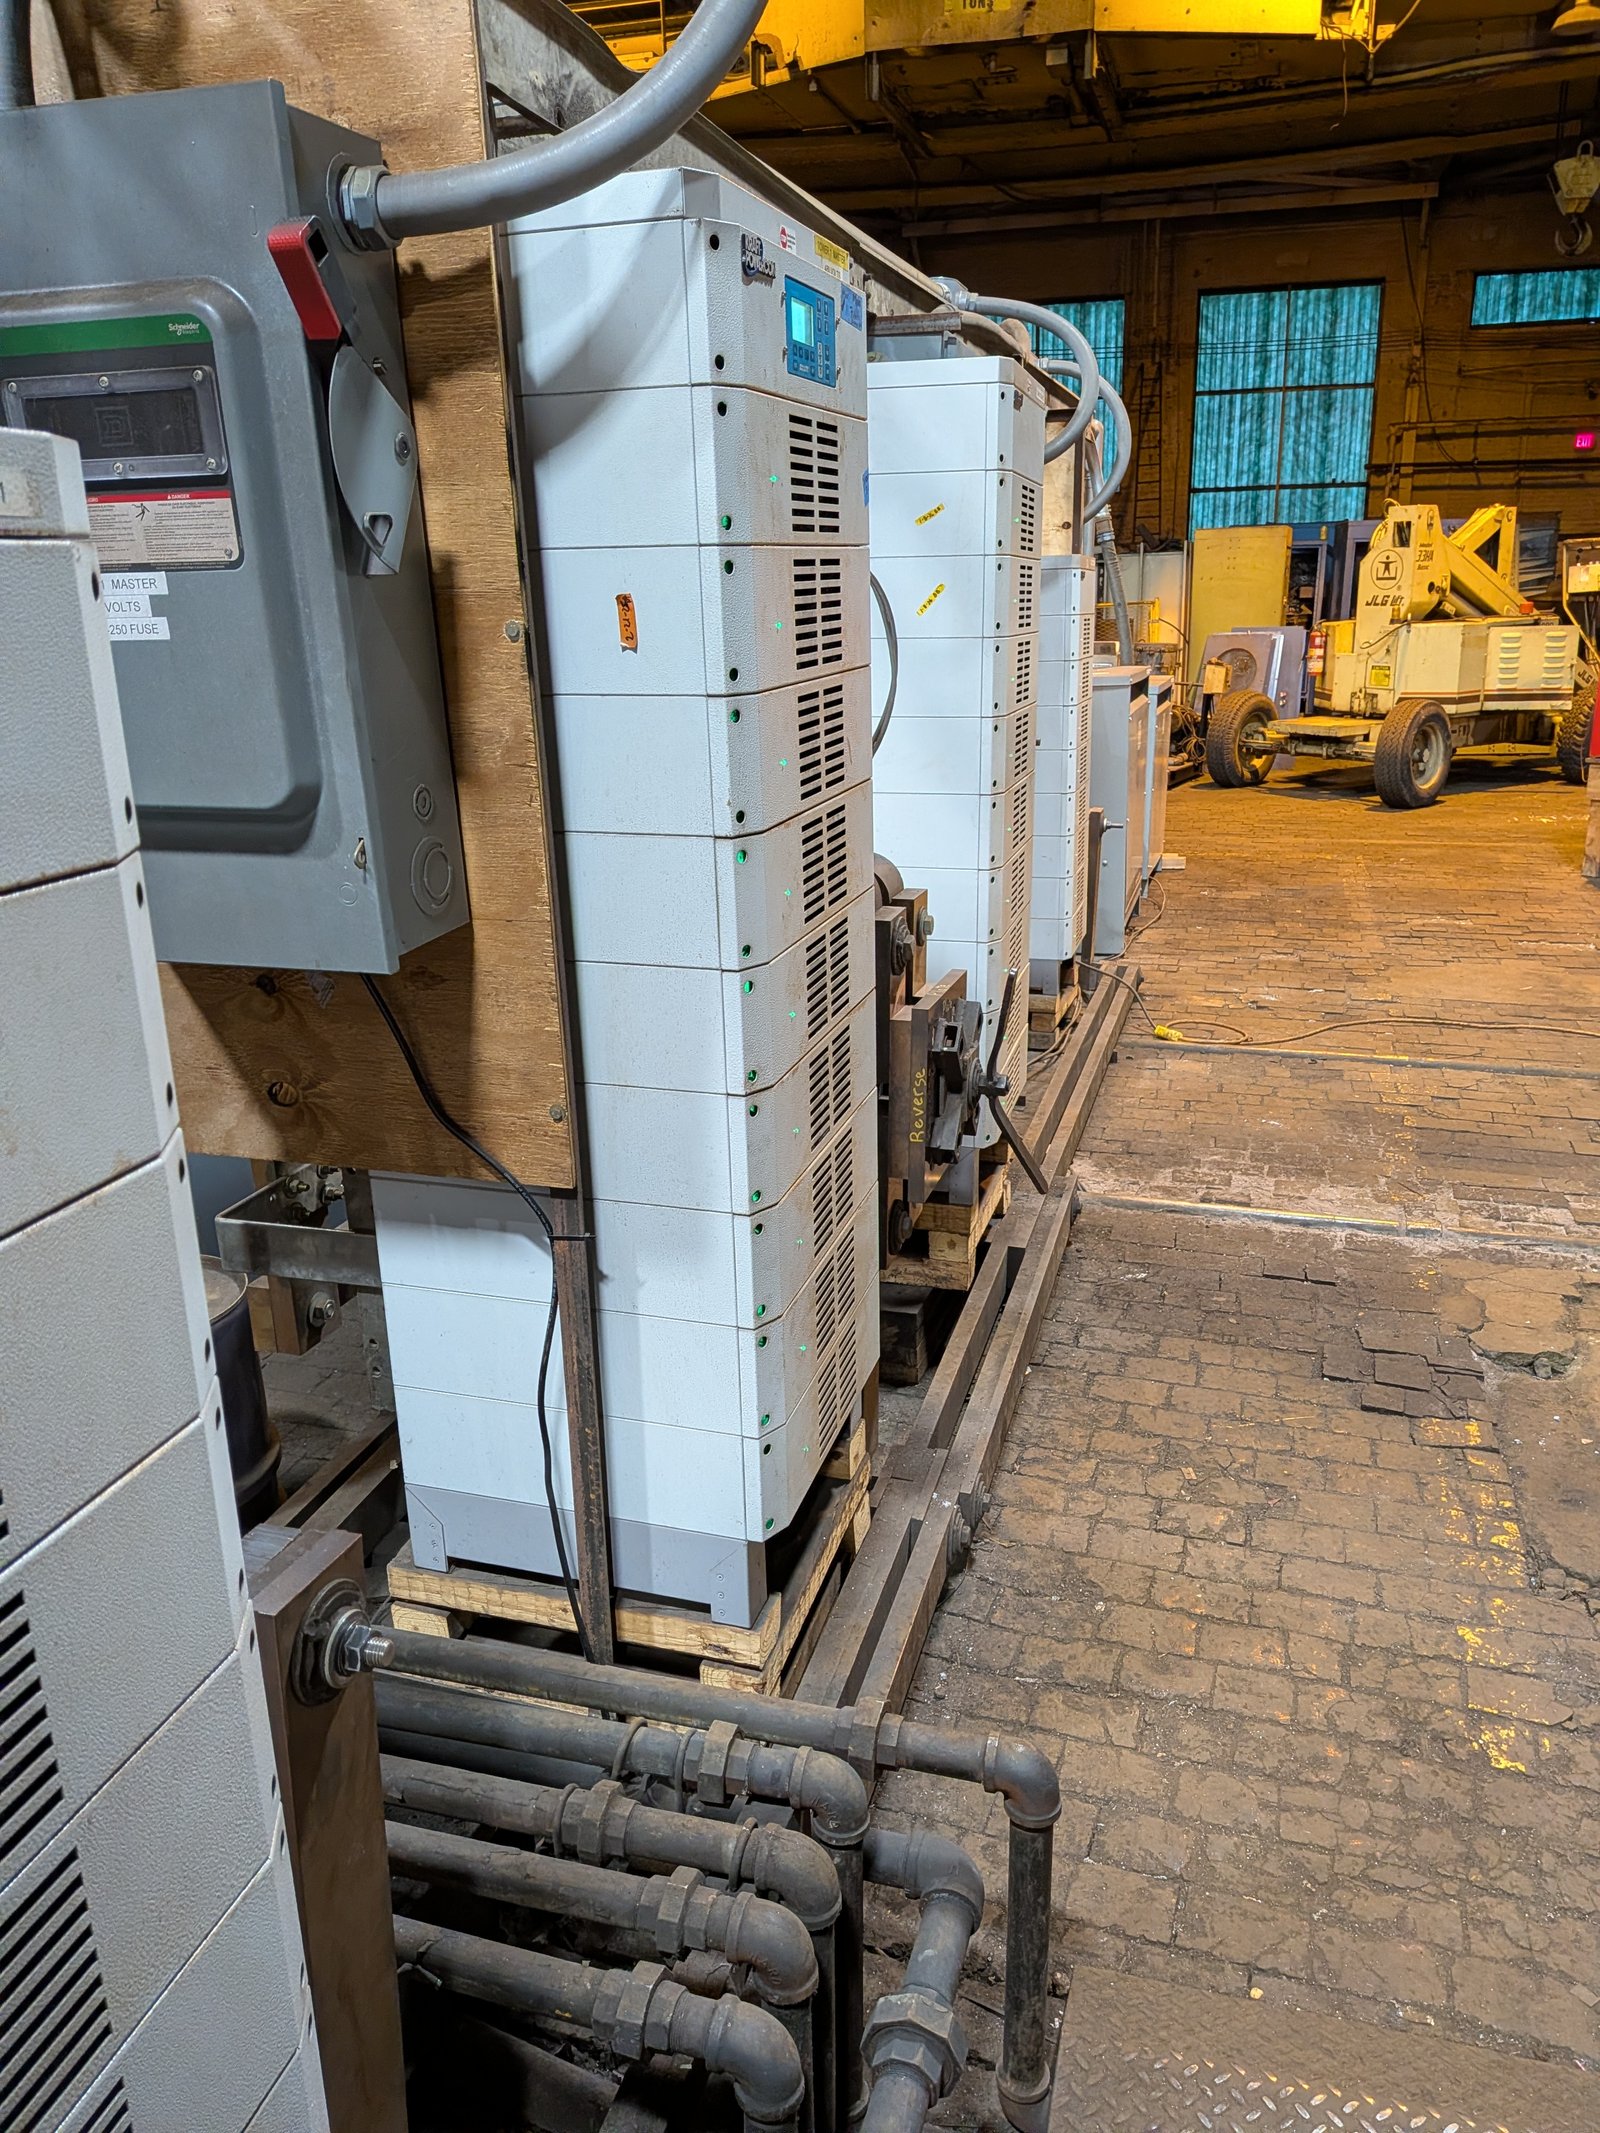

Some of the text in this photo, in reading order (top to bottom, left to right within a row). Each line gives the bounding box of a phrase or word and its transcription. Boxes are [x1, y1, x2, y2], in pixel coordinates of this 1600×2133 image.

[168, 322, 200, 331] Schneider
[1575, 434, 1592, 448] EXIT
[111, 578, 158, 590] MASTER
[104, 601, 141, 613] VOLTS
[1365, 595, 1390, 607] JLG
[130, 623, 160, 635] FUSE
[1578, 669, 1594, 684] JLG
[909, 1067, 927, 1143] Reverse
